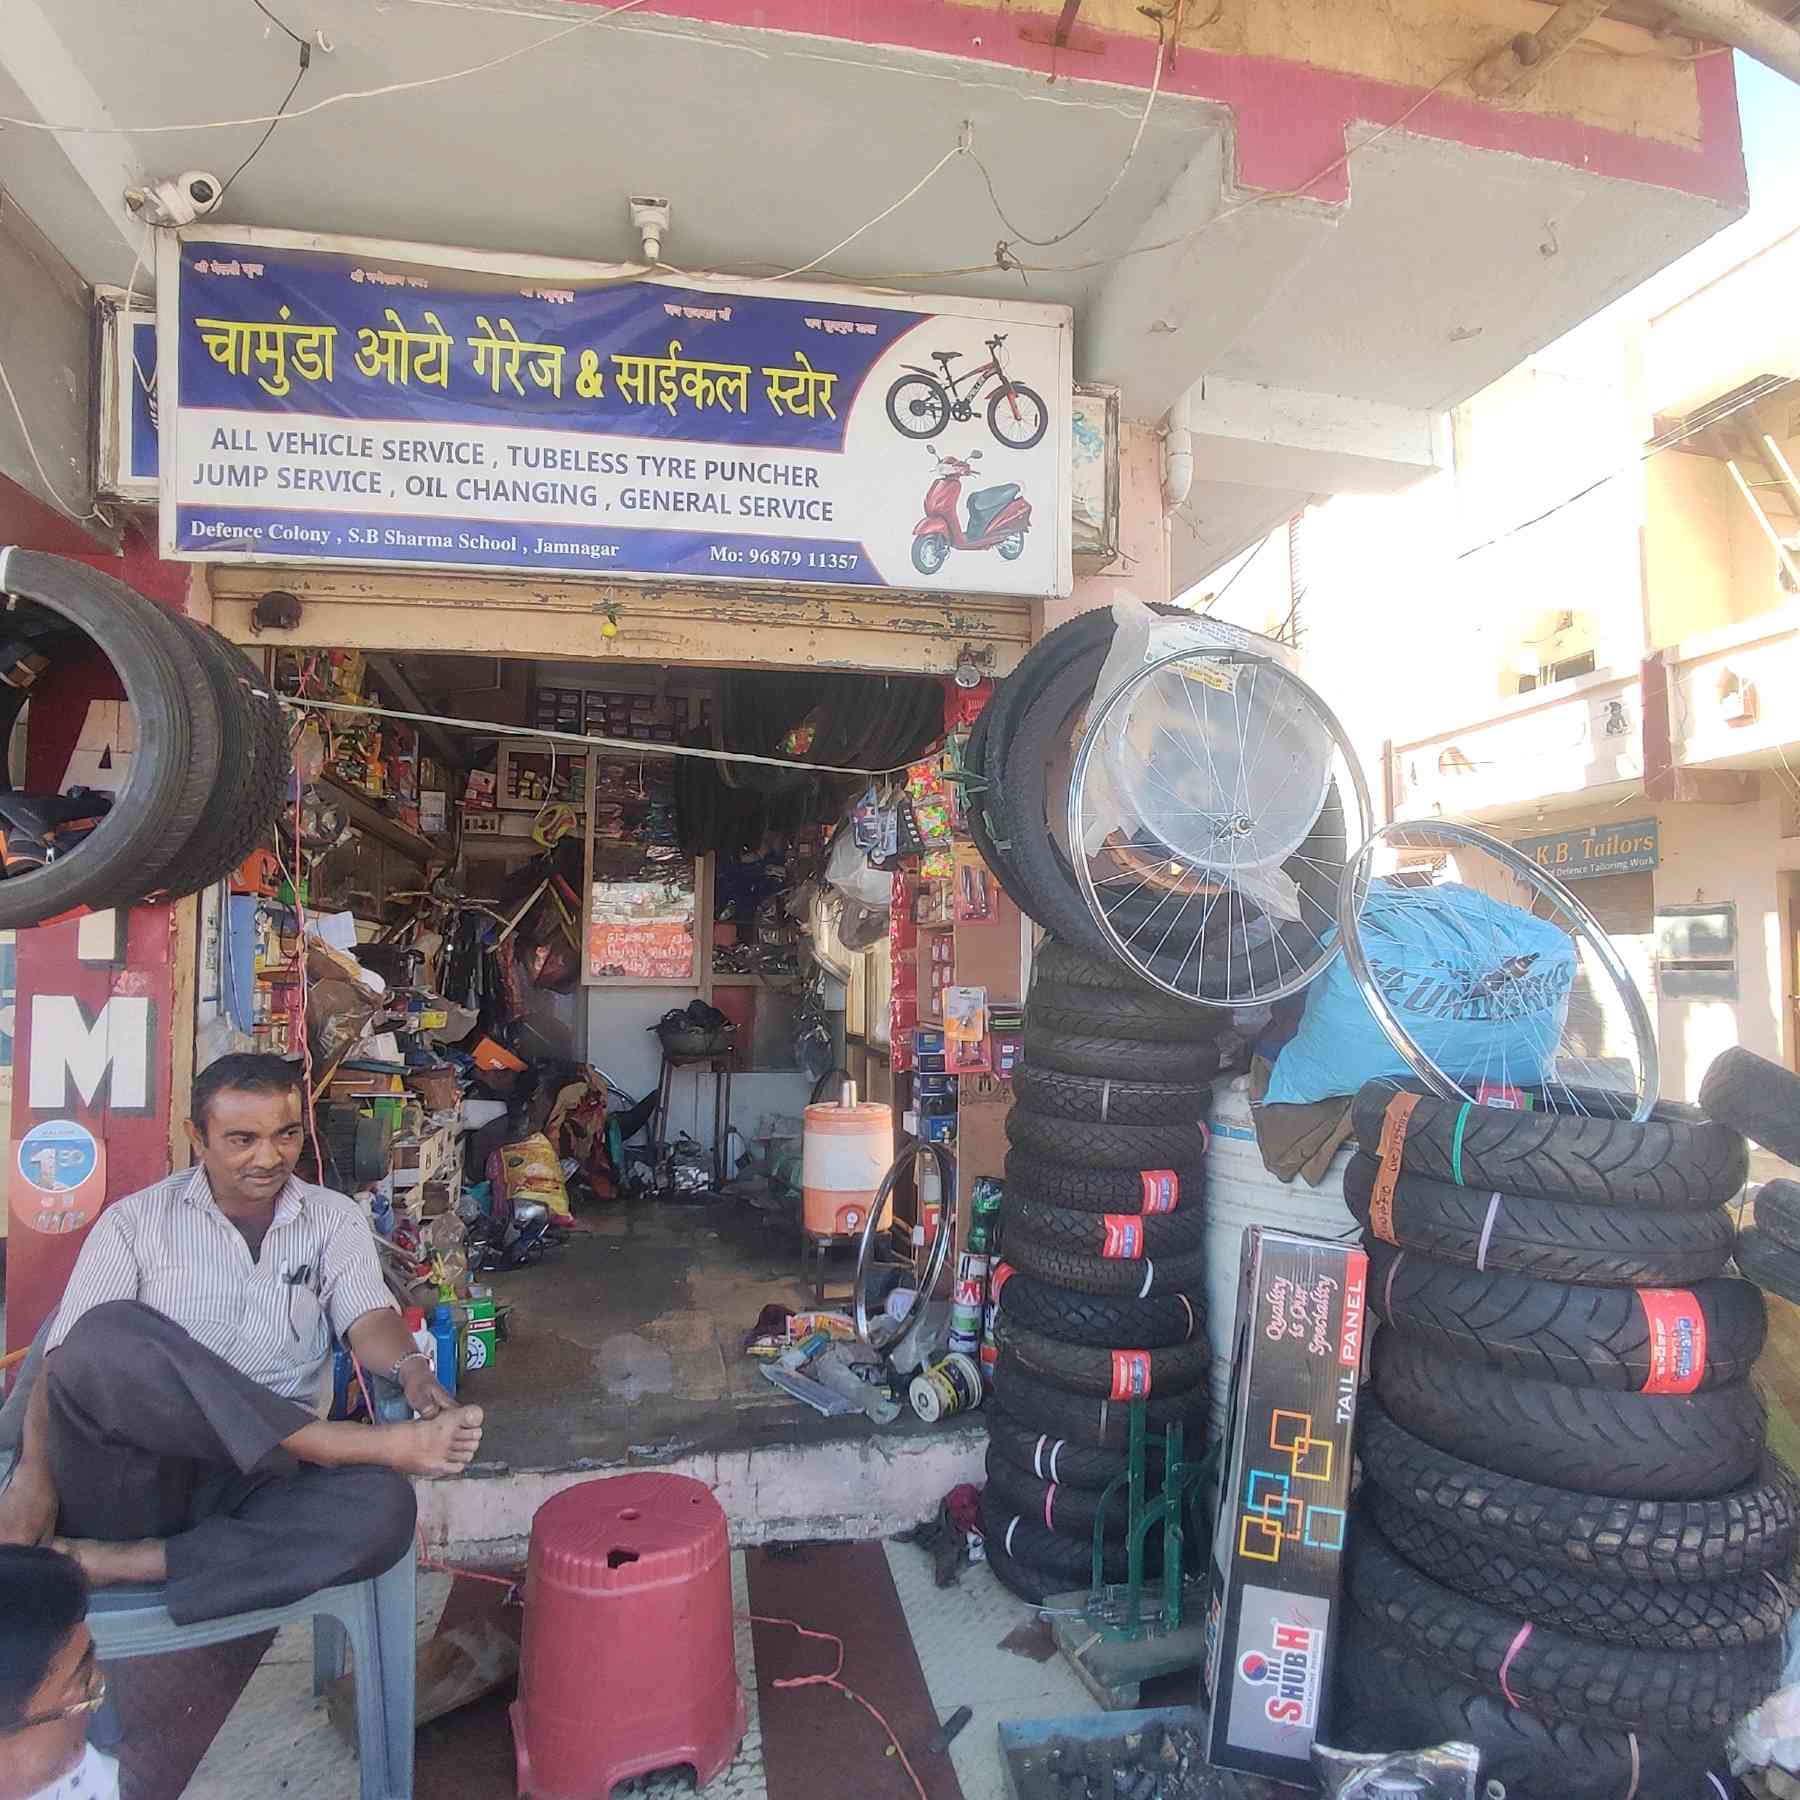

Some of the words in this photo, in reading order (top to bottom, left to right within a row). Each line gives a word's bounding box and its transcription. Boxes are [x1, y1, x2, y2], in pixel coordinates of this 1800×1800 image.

[194, 306, 338, 397] चामुंडा
[354, 309, 455, 390] ओटो
[467, 315, 566, 399] गेरेज
[575, 349, 605, 399] &
[611, 340, 752, 417] साईकल
[761, 351, 840, 422] स्टोर
[211, 427, 258, 453] ALL
[267, 431, 374, 459] VEHICLE
[382, 439, 485, 465] SERVICE
[507, 444, 628, 476] TUBELESS
[637, 455, 697, 480] TYRE
[704, 459, 819, 489] PUNCHER
[192, 463, 268, 490] JUMP
[276, 467, 382, 494] SERVICE
[404, 474, 448, 500] OIL
[456, 479, 598, 508] CHANGING
[619, 489, 732, 516] GENERAL
[738, 495, 834, 523] SERVICE
[190, 520, 263, 540] Defence
[267, 523, 331, 546] Colony
[348, 528, 379, 545] S.B
[384, 528, 454, 550] Sharma
[458, 532, 519, 553] School
[533, 537, 620, 559] Jamnagar
[709, 545, 744, 564] Mo:
[748, 547, 802, 568] 96879
[808, 550, 859, 571] 11357
[1581, 832, 1655, 859] Tailors
[1629, 857, 1656, 868] Work
[1266, 1275, 1294, 1342] Quality
[1342, 1279, 1363, 1361] PANEL
[1336, 1369, 1355, 1424] TAIL
[1267, 1624, 1311, 1724] SHUBH
